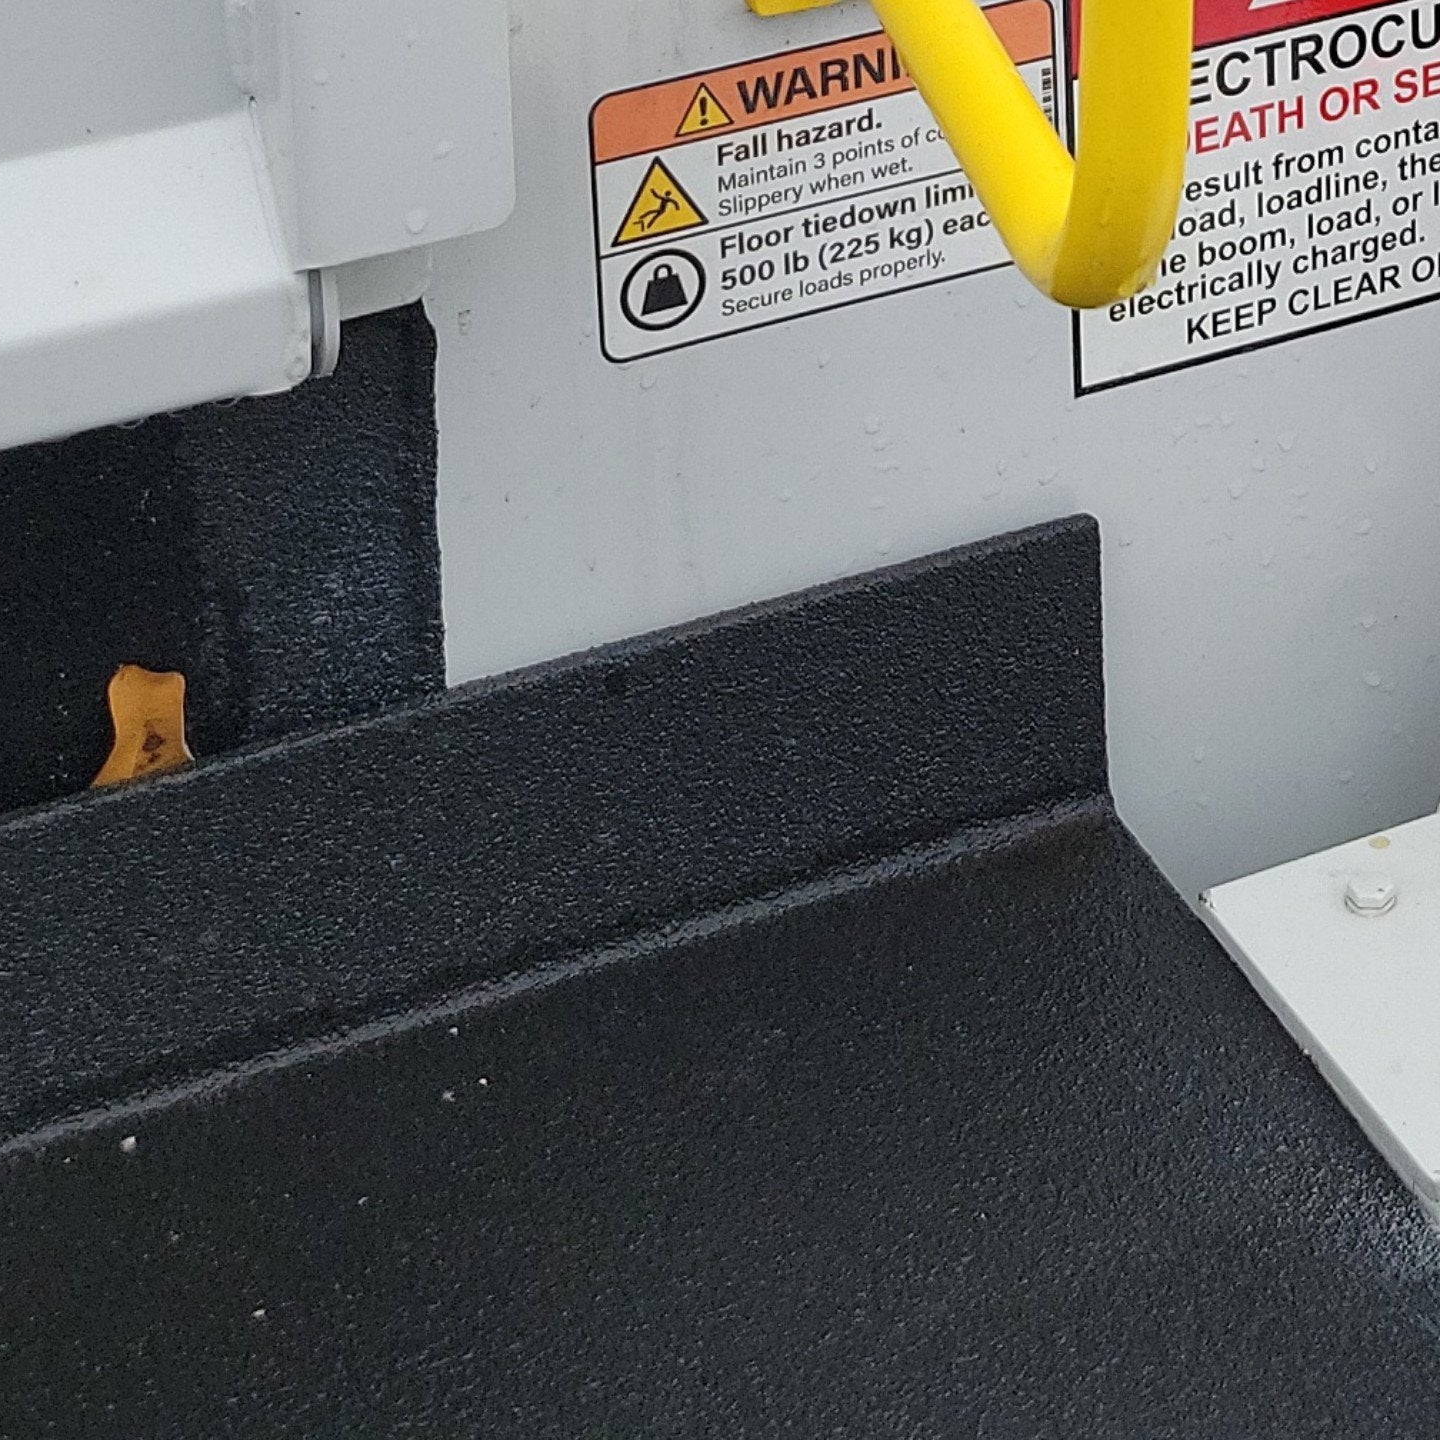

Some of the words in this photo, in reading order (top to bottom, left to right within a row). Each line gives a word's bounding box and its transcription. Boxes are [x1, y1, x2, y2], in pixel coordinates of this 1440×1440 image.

[736, 44, 908, 114] WARNI
[718, 133, 767, 166] Fall
[777, 108, 881, 151] hazard.
[1188, 96, 1303, 154] EATH
[1320, 79, 1380, 121] OR
[719, 161, 806, 192] Maintain
[814, 153, 825, 168] 3
[833, 139, 894, 168] points
[902, 128, 919, 148] of
[719, 186, 802, 216] Slippery
[810, 172, 864, 194] when
[872, 158, 912, 178] wet.
[1183, 161, 1262, 201] esult
[1273, 146, 1343, 180] from
[1258, 171, 1386, 217] loadline,
[721, 226, 794, 258] Floor
[802, 197, 916, 237] tiedown
[722, 260, 774, 290] 500
[784, 251, 809, 274] lb
[819, 233, 879, 270] (225
[890, 219, 933, 250] kg)
[943, 212, 990, 234] eac
[1199, 229, 1294, 267] boom,
[1308, 199, 1380, 239] load,
[1393, 192, 1423, 216] or
[723, 289, 792, 316] Secure
[800, 271, 853, 297] loads
[860, 250, 945, 285] properly.
[1110, 260, 1281, 321] electrically
[1293, 219, 1424, 274] charged.
[1188, 298, 1276, 344] KEEP
[1289, 265, 1401, 315] CLEAR
